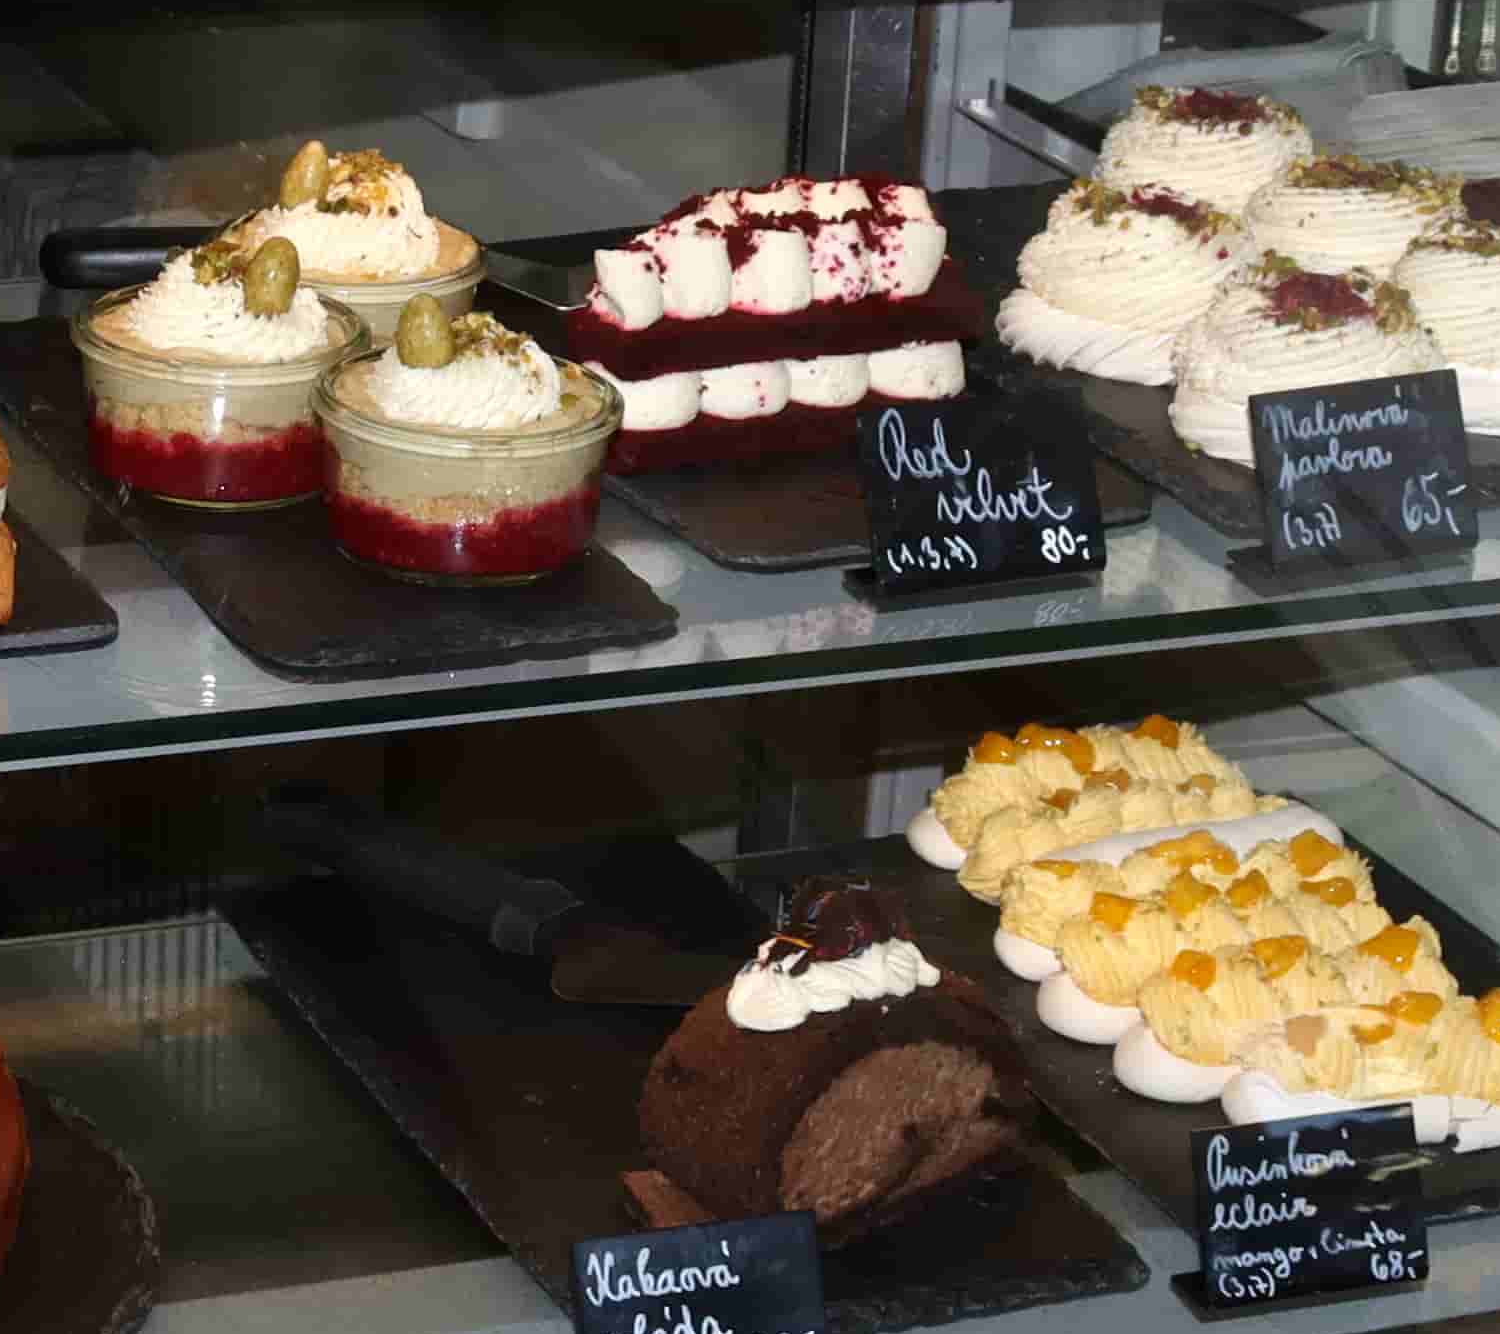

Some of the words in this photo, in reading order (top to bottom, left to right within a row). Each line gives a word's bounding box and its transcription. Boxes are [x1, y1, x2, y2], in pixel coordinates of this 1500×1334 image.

[1263, 384, 1408, 443] Malinová
[879, 408, 970, 480] Red
[1279, 437, 1393, 491] pavlova
[937, 467, 1072, 523] velvet
[586, 1239, 740, 1306] Kakaová
